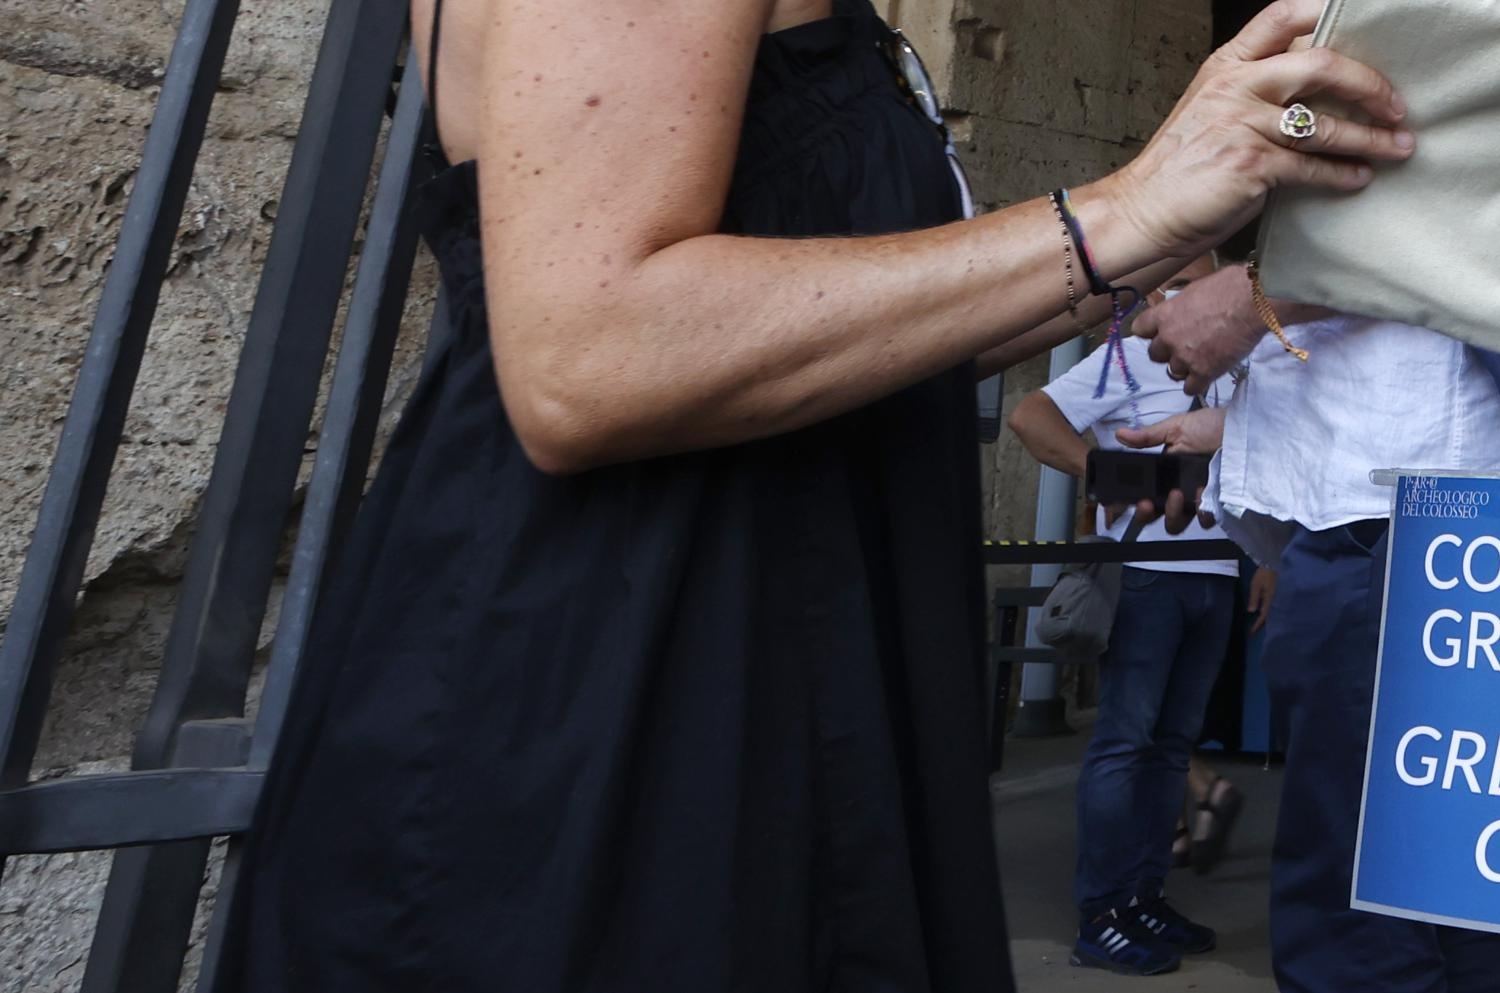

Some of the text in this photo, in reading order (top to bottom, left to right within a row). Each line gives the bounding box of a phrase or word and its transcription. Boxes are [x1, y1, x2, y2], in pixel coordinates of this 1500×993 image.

[1403, 489, 1490, 506] ARCHEOLOGICO
[1402, 503, 1478, 519] DEL COLOSSEO
